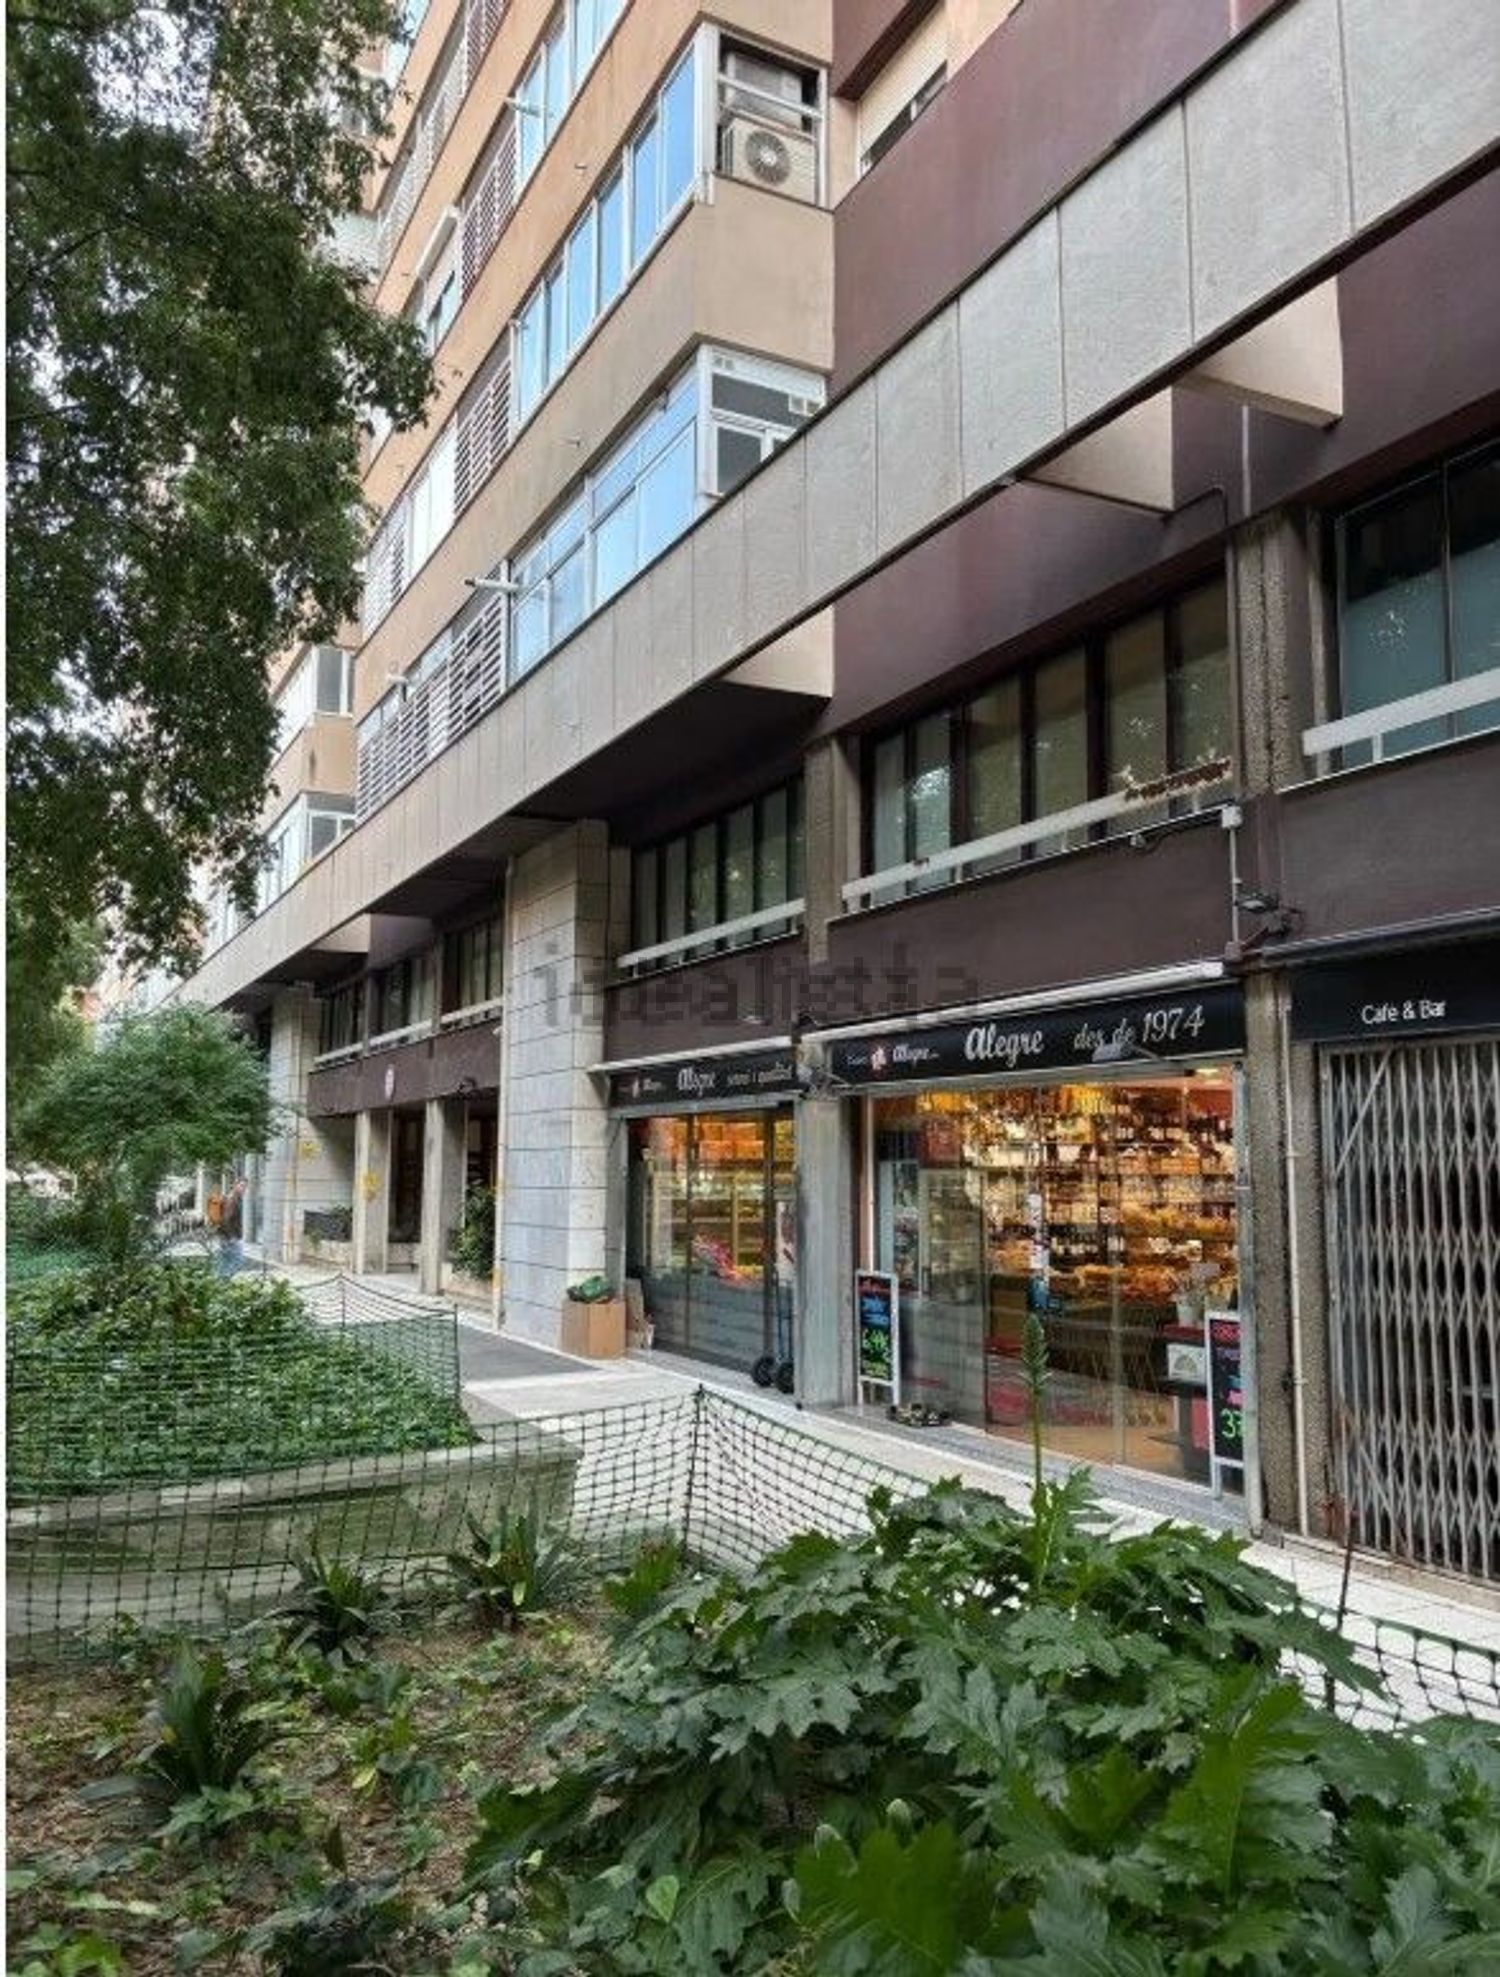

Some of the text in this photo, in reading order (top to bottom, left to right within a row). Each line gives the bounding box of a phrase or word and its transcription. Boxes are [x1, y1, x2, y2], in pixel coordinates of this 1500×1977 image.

[1402, 1000, 1416, 1019] &
[1419, 999, 1446, 1018] Bar
[964, 1023, 1043, 1067] Alegre
[1142, 1005, 1205, 1043] 1974
